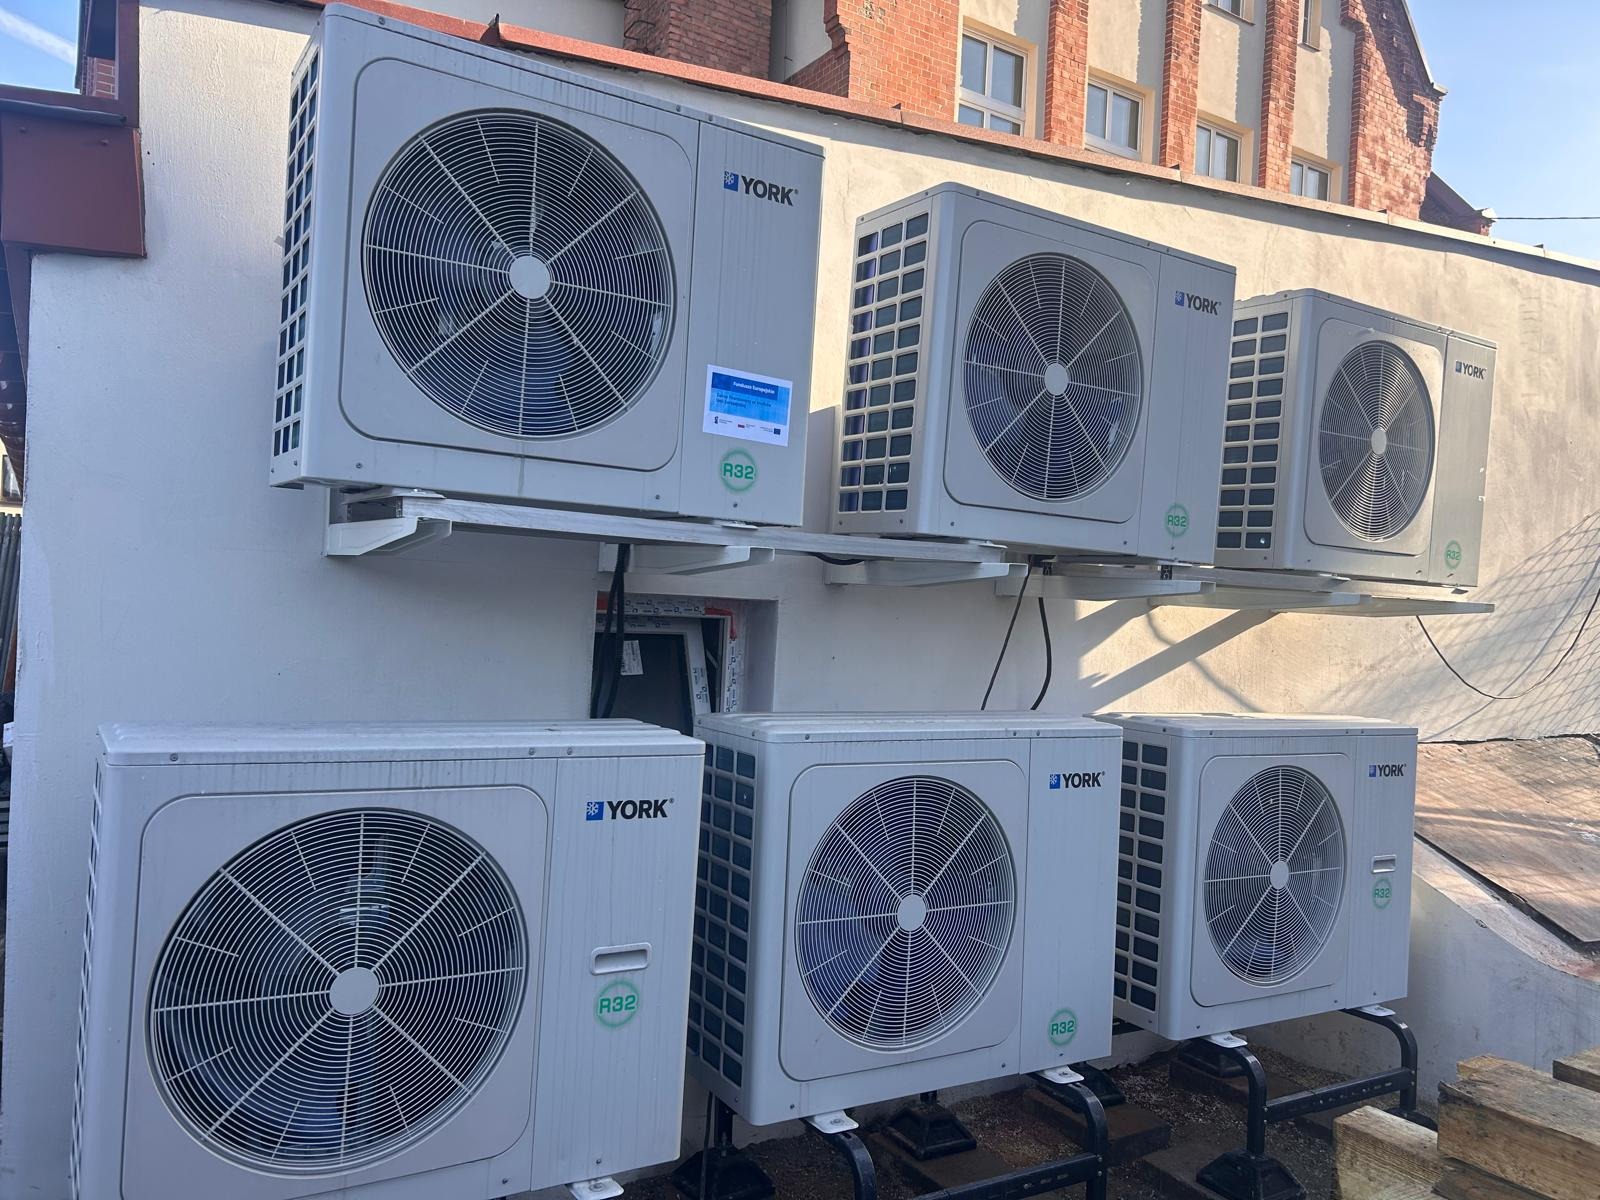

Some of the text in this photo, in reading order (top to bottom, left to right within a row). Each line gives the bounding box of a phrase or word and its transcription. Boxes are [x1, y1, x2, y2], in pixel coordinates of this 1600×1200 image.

[741, 175, 794, 206] YORK
[1186, 293, 1218, 315] YORK
[1462, 362, 1484, 379] YORK
[723, 462, 754, 480] R32
[1167, 514, 1187, 528] R32
[1447, 549, 1460, 560] R32
[1377, 764, 1404, 777] YORK
[1062, 772, 1102, 788] YORK
[606, 799, 668, 820] YORK
[1375, 888, 1390, 898] R32
[599, 994, 636, 1014] R32
[1051, 1020, 1075, 1035] R32
